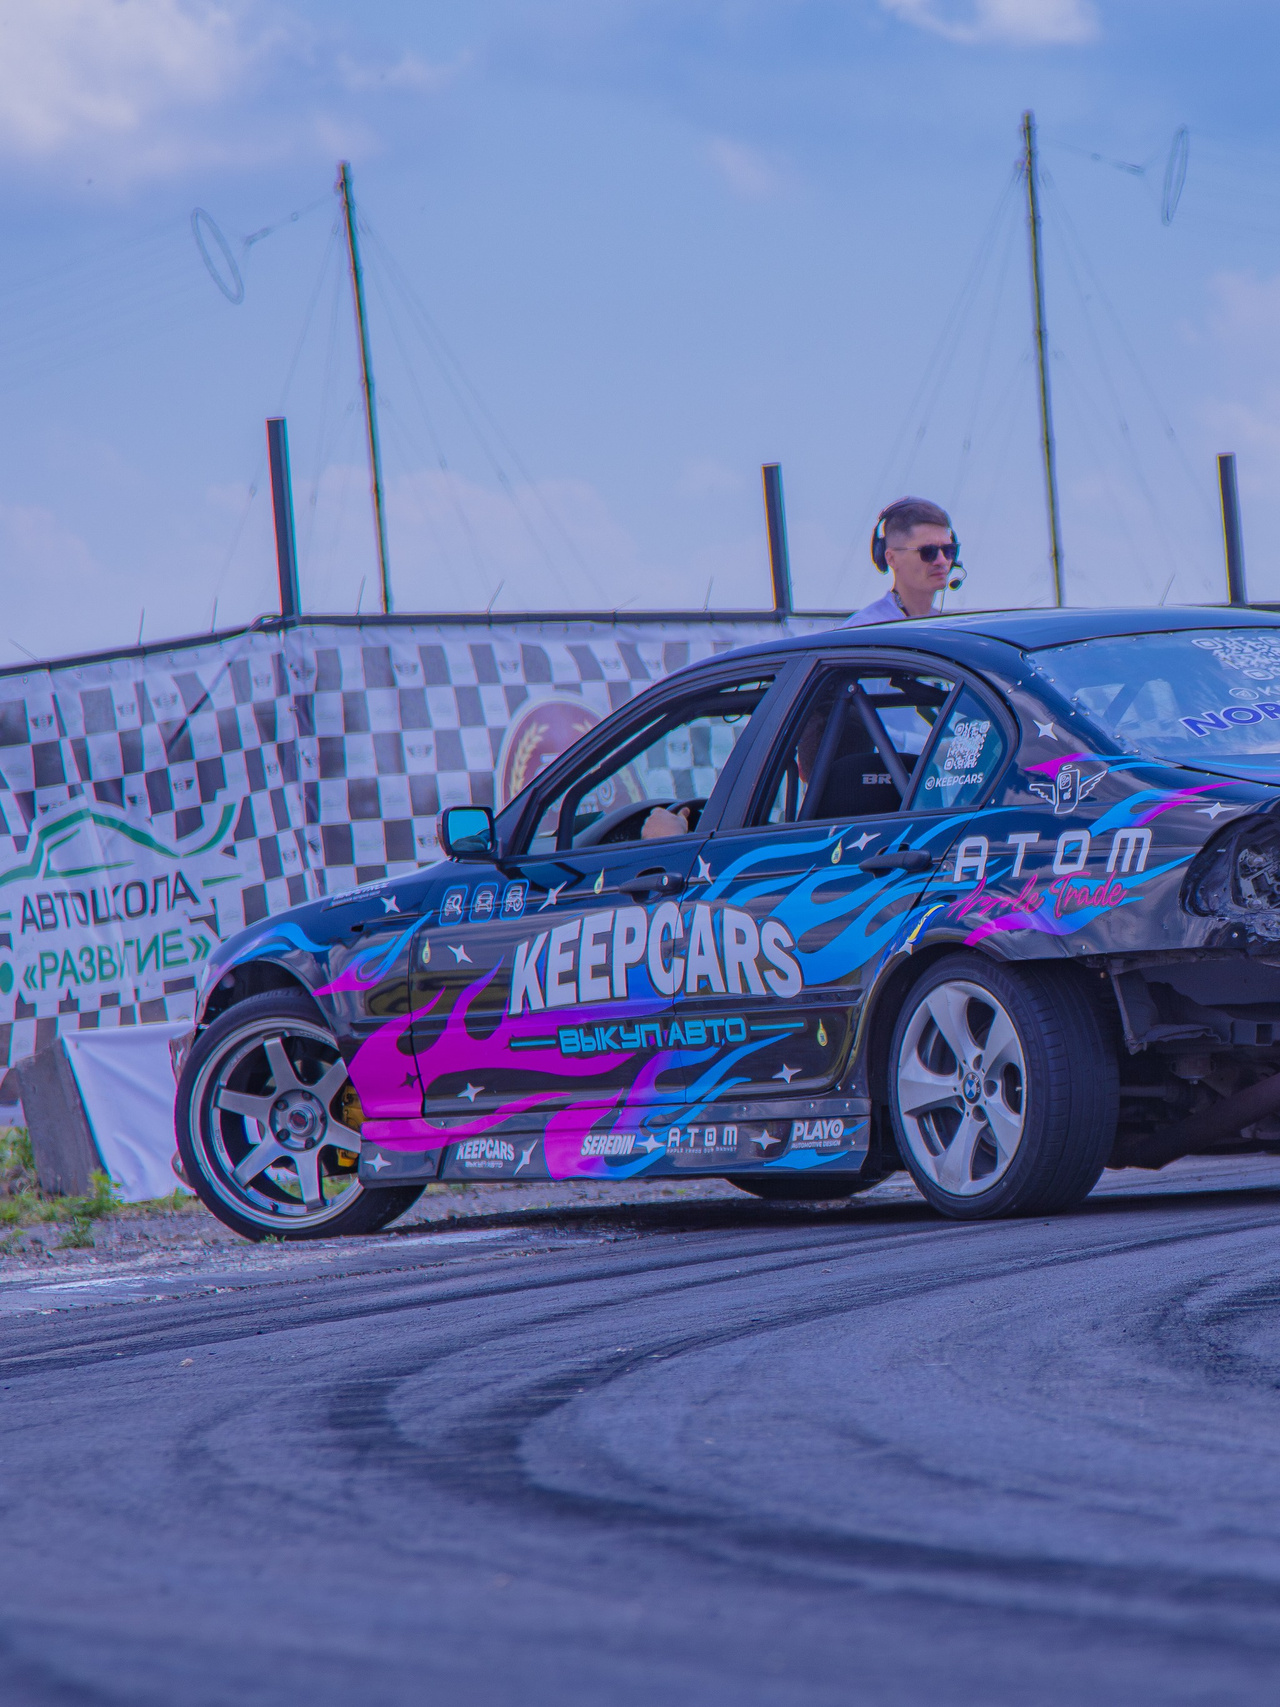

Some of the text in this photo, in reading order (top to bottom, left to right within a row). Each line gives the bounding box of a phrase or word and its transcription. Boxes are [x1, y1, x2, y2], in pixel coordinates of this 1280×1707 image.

[935, 772, 984, 788] KEEPCARS
[953, 828, 1152, 882] ATOM
[947, 870, 1128, 921] Apple Trade
[507, 901, 803, 1015] KEEPCARS
[558, 1017, 747, 1054] ВЫКУП АВТО
[667, 1125, 738, 1147] ATOM
[791, 1119, 844, 1141] PLAYO
[455, 1137, 515, 1161] KEEPCARS
[581, 1134, 635, 1156] SEREDIN
